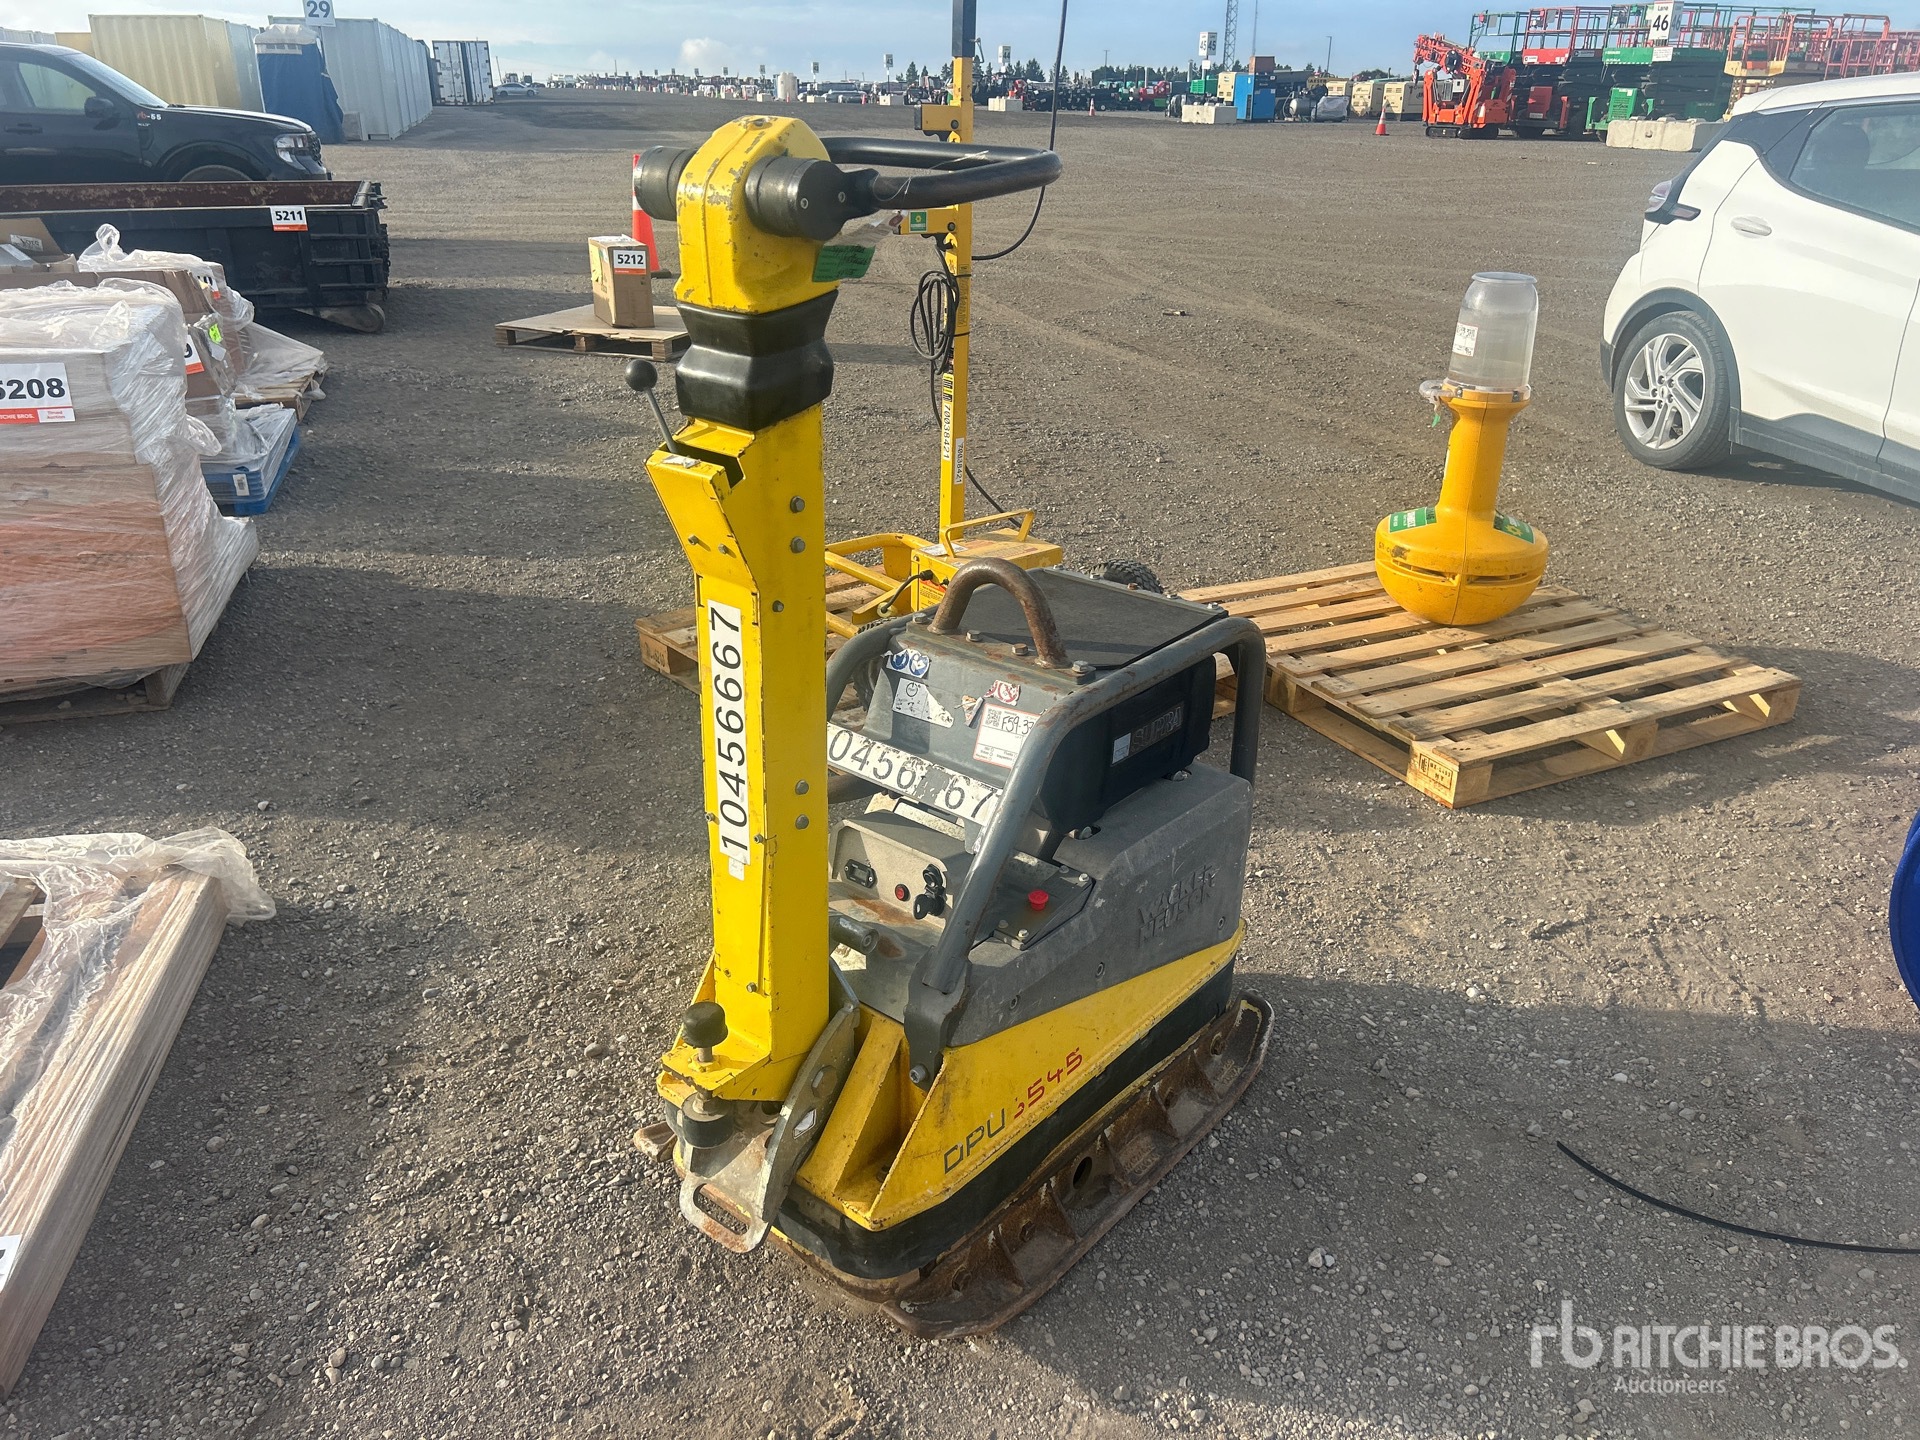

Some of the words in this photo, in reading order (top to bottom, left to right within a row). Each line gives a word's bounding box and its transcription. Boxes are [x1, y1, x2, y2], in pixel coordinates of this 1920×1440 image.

[306, 0, 331, 18] 29
[1652, 14, 1669, 31] 46
[1208, 40, 1216, 51] 45
[275, 210, 304, 221] 5211
[617, 254, 644, 265] 5212
[710, 607, 748, 852] 1045667
[944, 1108, 1005, 1174] DPU
